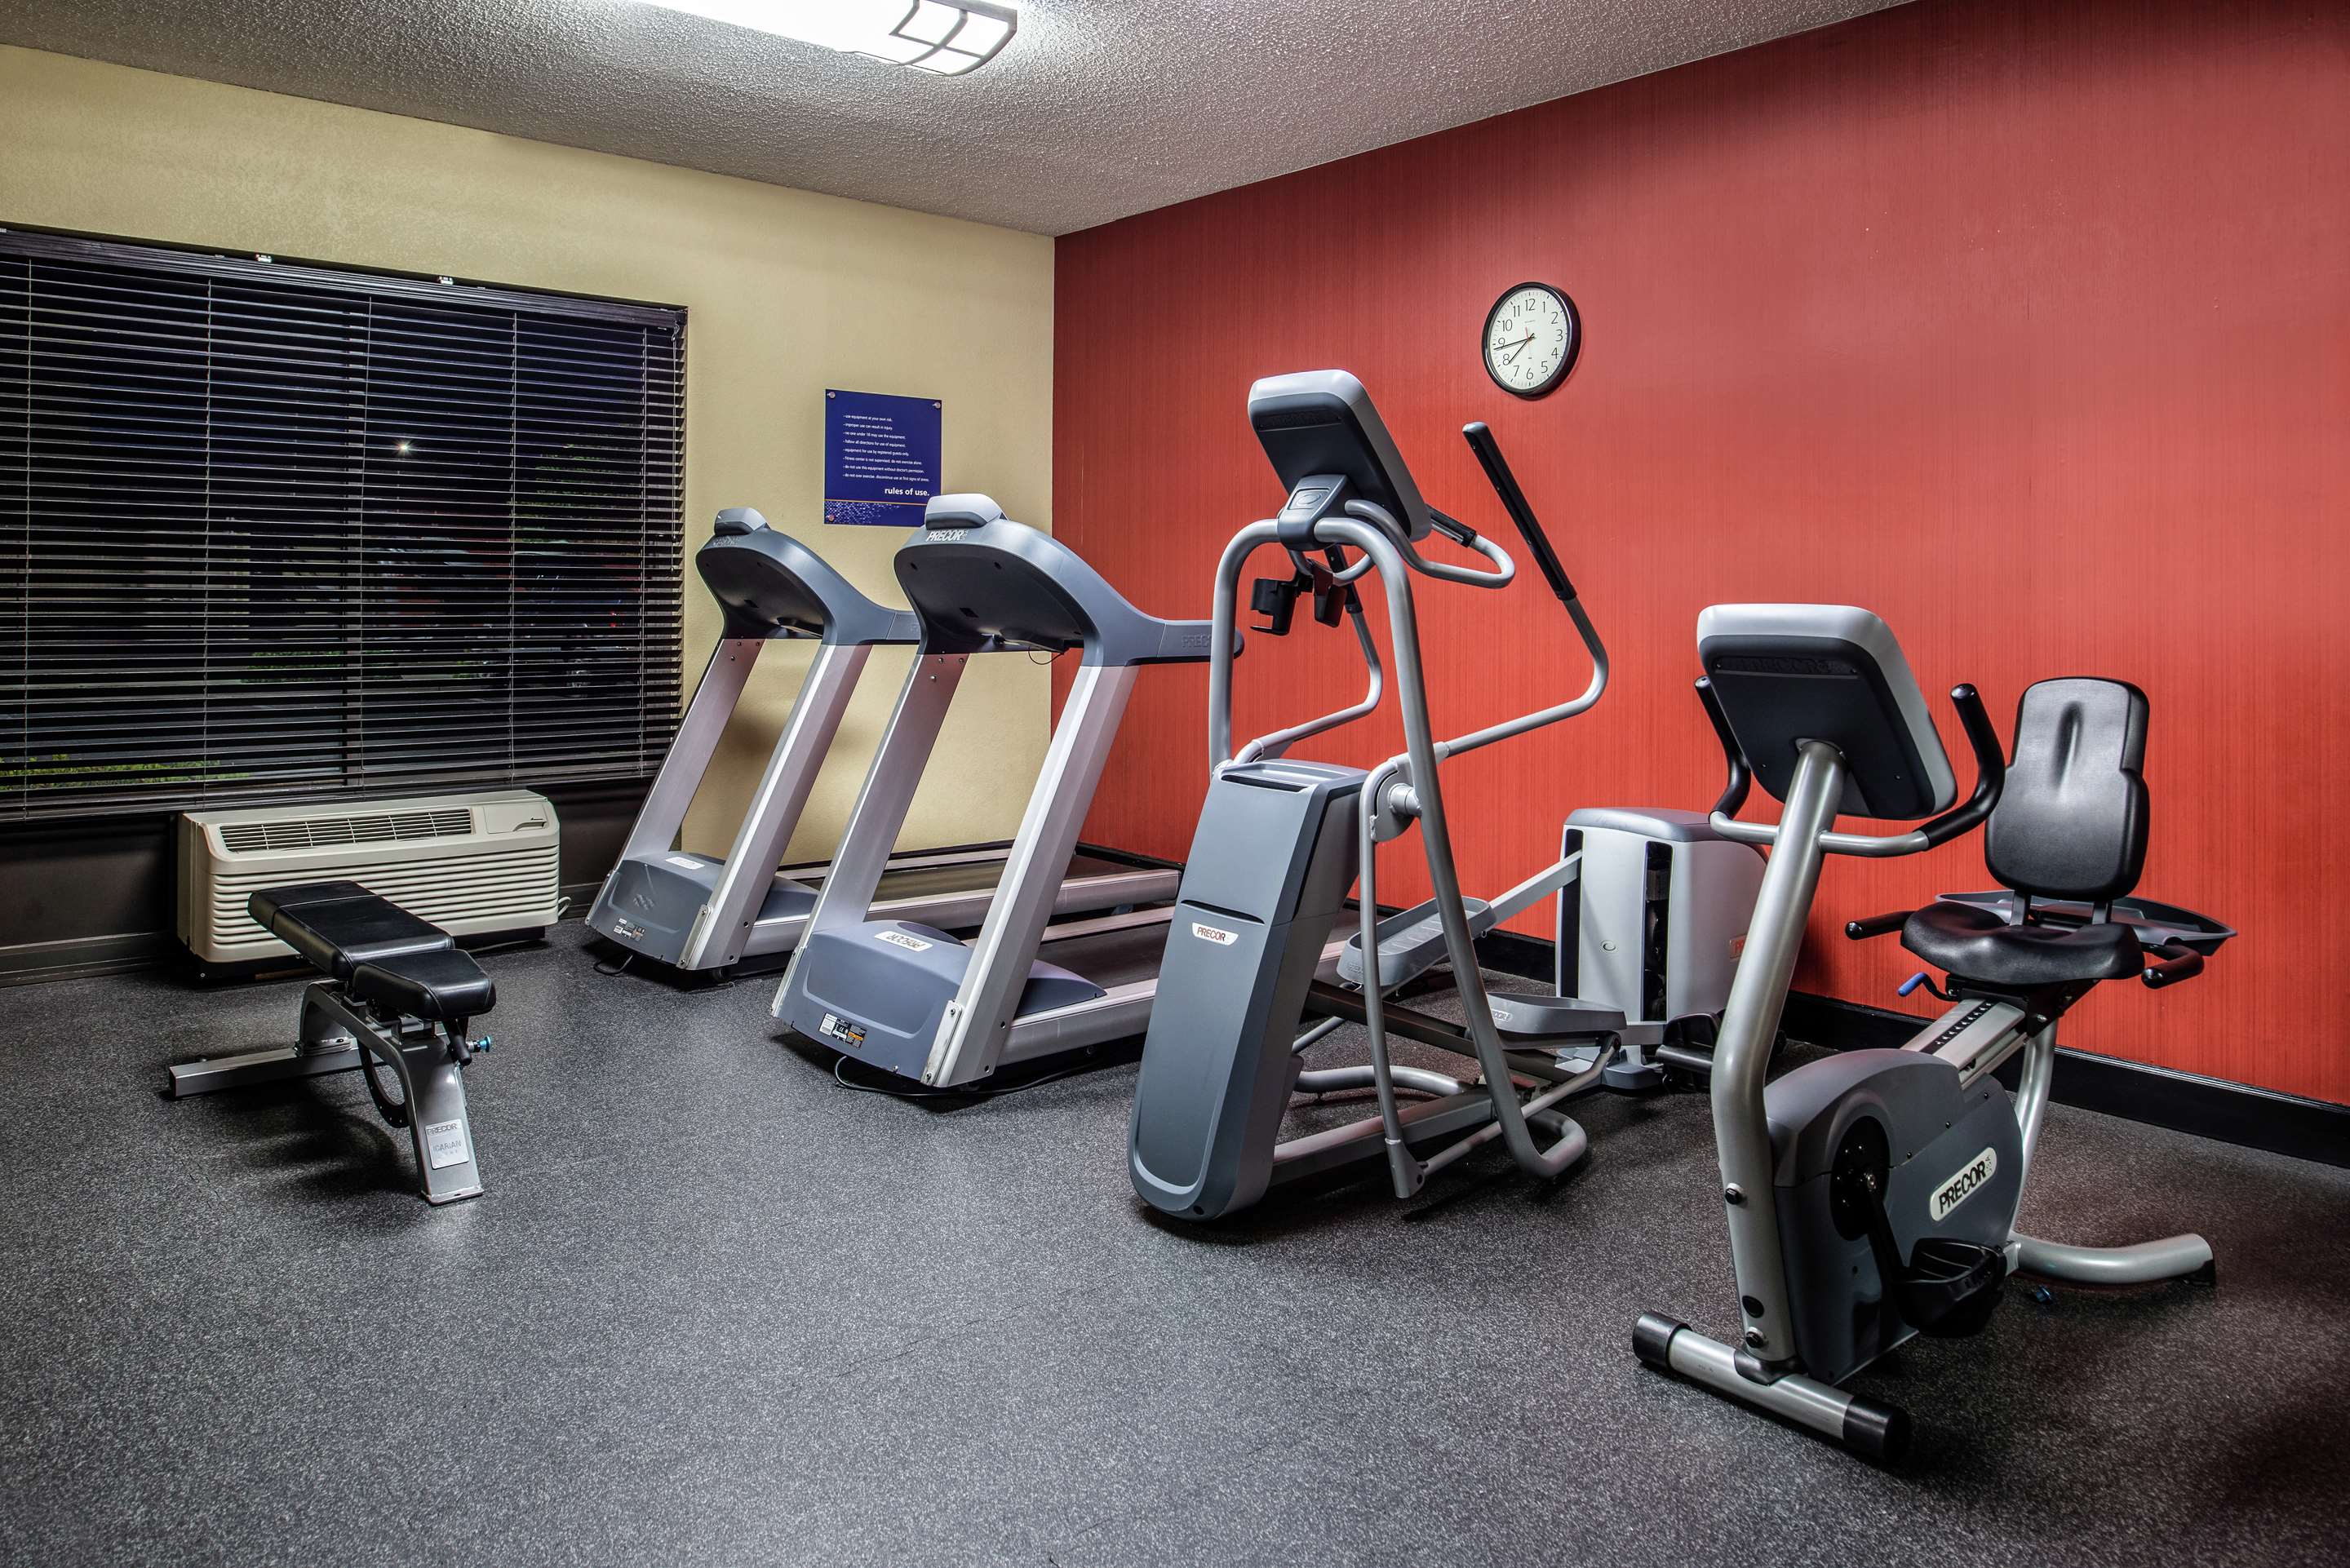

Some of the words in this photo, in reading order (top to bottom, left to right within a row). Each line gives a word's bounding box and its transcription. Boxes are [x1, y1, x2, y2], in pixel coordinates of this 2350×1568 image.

[1525, 297, 1536, 312] 12
[1542, 301, 1546, 314] 1
[1513, 305, 1520, 318] 11
[1551, 311, 1559, 325] 2
[1502, 319, 1513, 332] 10
[1556, 329, 1563, 342] 3
[1498, 337, 1505, 349] 9
[1502, 353, 1510, 366] 8
[1551, 347, 1559, 359] 4
[1513, 364, 1520, 377] 7
[1526, 367, 1534, 380] 6
[1541, 360, 1549, 374] 5
[885, 487, 903, 495] rules
[925, 529, 964, 542] PRECOR
[1181, 633, 1212, 647] PREC
[1197, 927, 1226, 941] PRECOR
[426, 1123, 457, 1136] PRECOR
[1939, 1160, 1986, 1215] PRECOR
